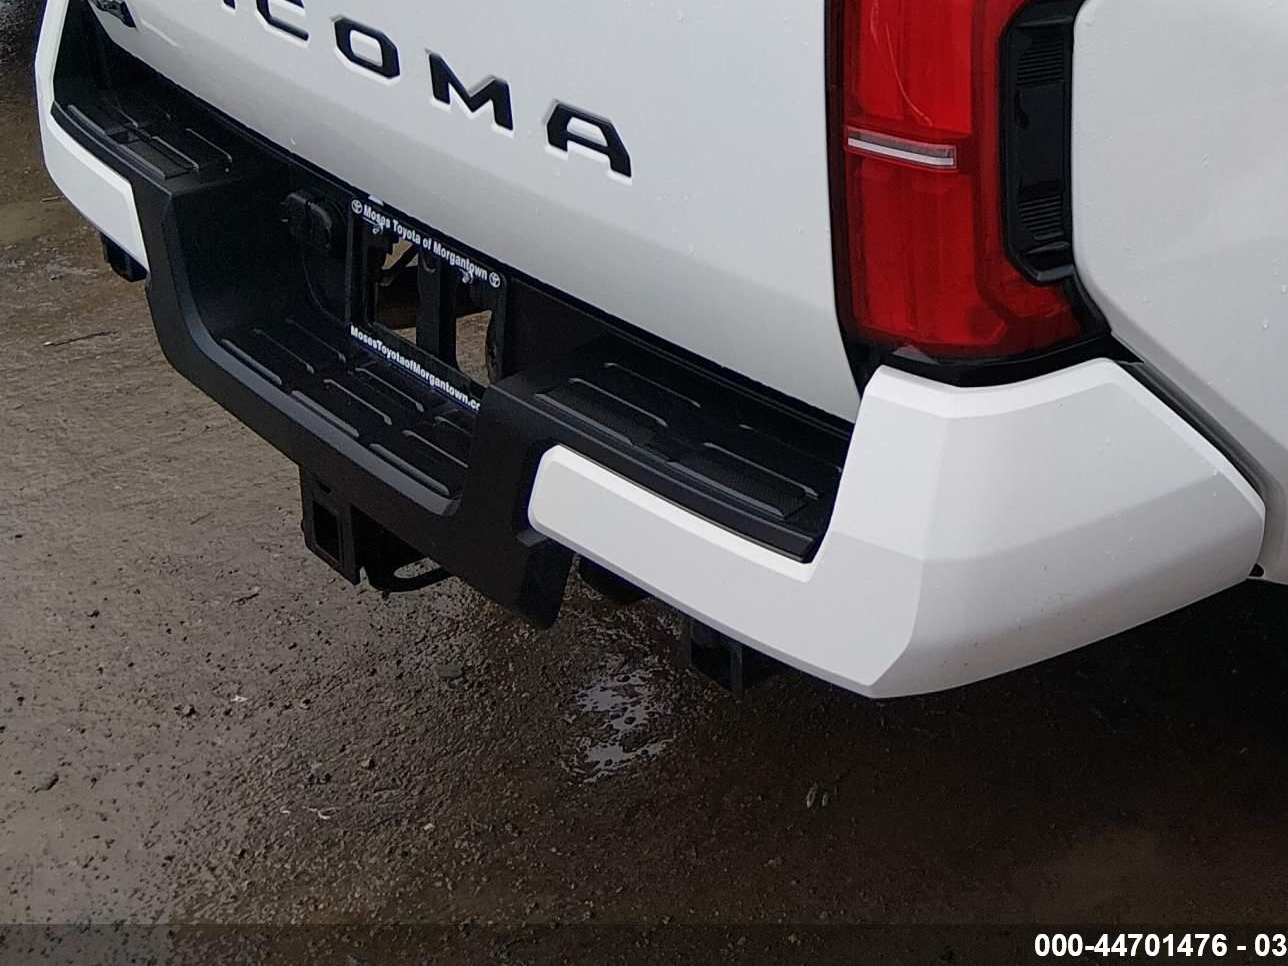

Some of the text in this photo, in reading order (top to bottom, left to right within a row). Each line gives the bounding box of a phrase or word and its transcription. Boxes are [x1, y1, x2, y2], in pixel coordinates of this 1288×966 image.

[363, 204, 488, 281] Moses Toyota of Morgantown
